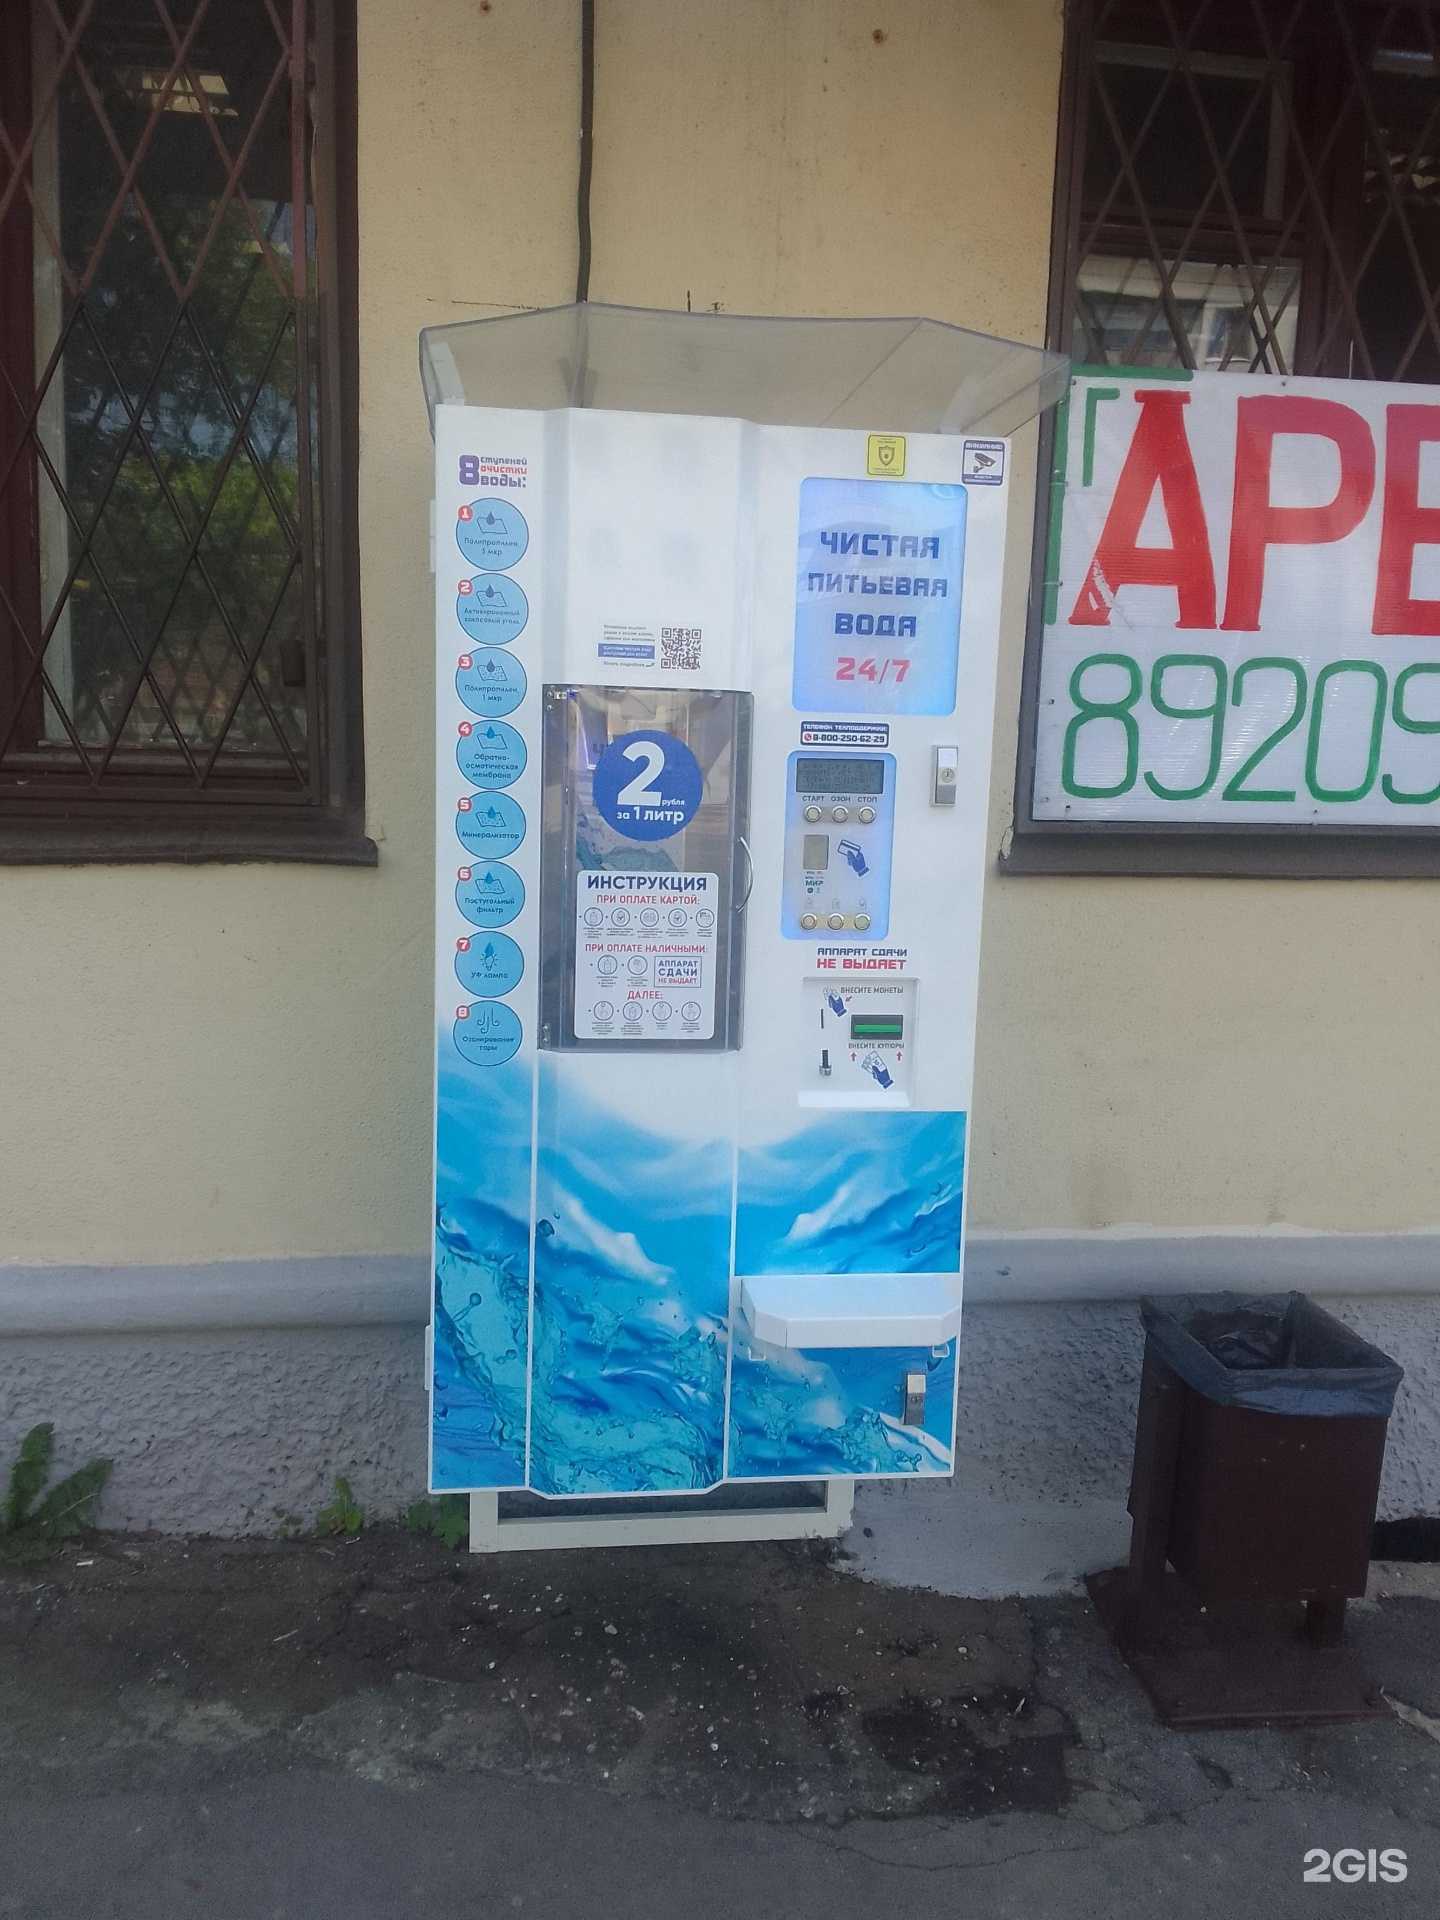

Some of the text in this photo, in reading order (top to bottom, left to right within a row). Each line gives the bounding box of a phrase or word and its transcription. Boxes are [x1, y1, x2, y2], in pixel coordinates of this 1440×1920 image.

[459, 454, 528, 486] 8 ступеней
[480, 465, 528, 475] очистки
[480, 474, 527, 488] воды:
[820, 531, 940, 560] ЧИСТАЯ
[460, 581, 471, 593] 2
[807, 572, 948, 598] ПИТЬЕВАЯ
[834, 612, 917, 638] ВОДА
[460, 655, 470, 668] 3
[835, 656, 911, 684] 24/7
[459, 723, 469, 735] 4
[616, 740, 665, 807] 2
[459, 798, 469, 810] 5
[661, 799, 685, 807] рубля
[616, 806, 684, 825] за 1 литр
[462, 831, 520, 840] Минерализатор
[587, 874, 707, 893] ИНСТРУКЦИЯ
[596, 894, 701, 905] ПРИ ОПЛАТЕ КАРТОЙ:
[585, 943, 604, 952] ПРИ
[607, 943, 642, 953] ОПЛАТЕ
[817, 947, 908, 957] АППАРАТ СДАЧИ
[816, 958, 907, 970] НЕ ВЫДАЕТ
[658, 967, 698, 977] СДАЧИ
[627, 990, 664, 1001] ДАЛЕЕ:
[840, 986, 872, 994] ВНЕСИТЕ
